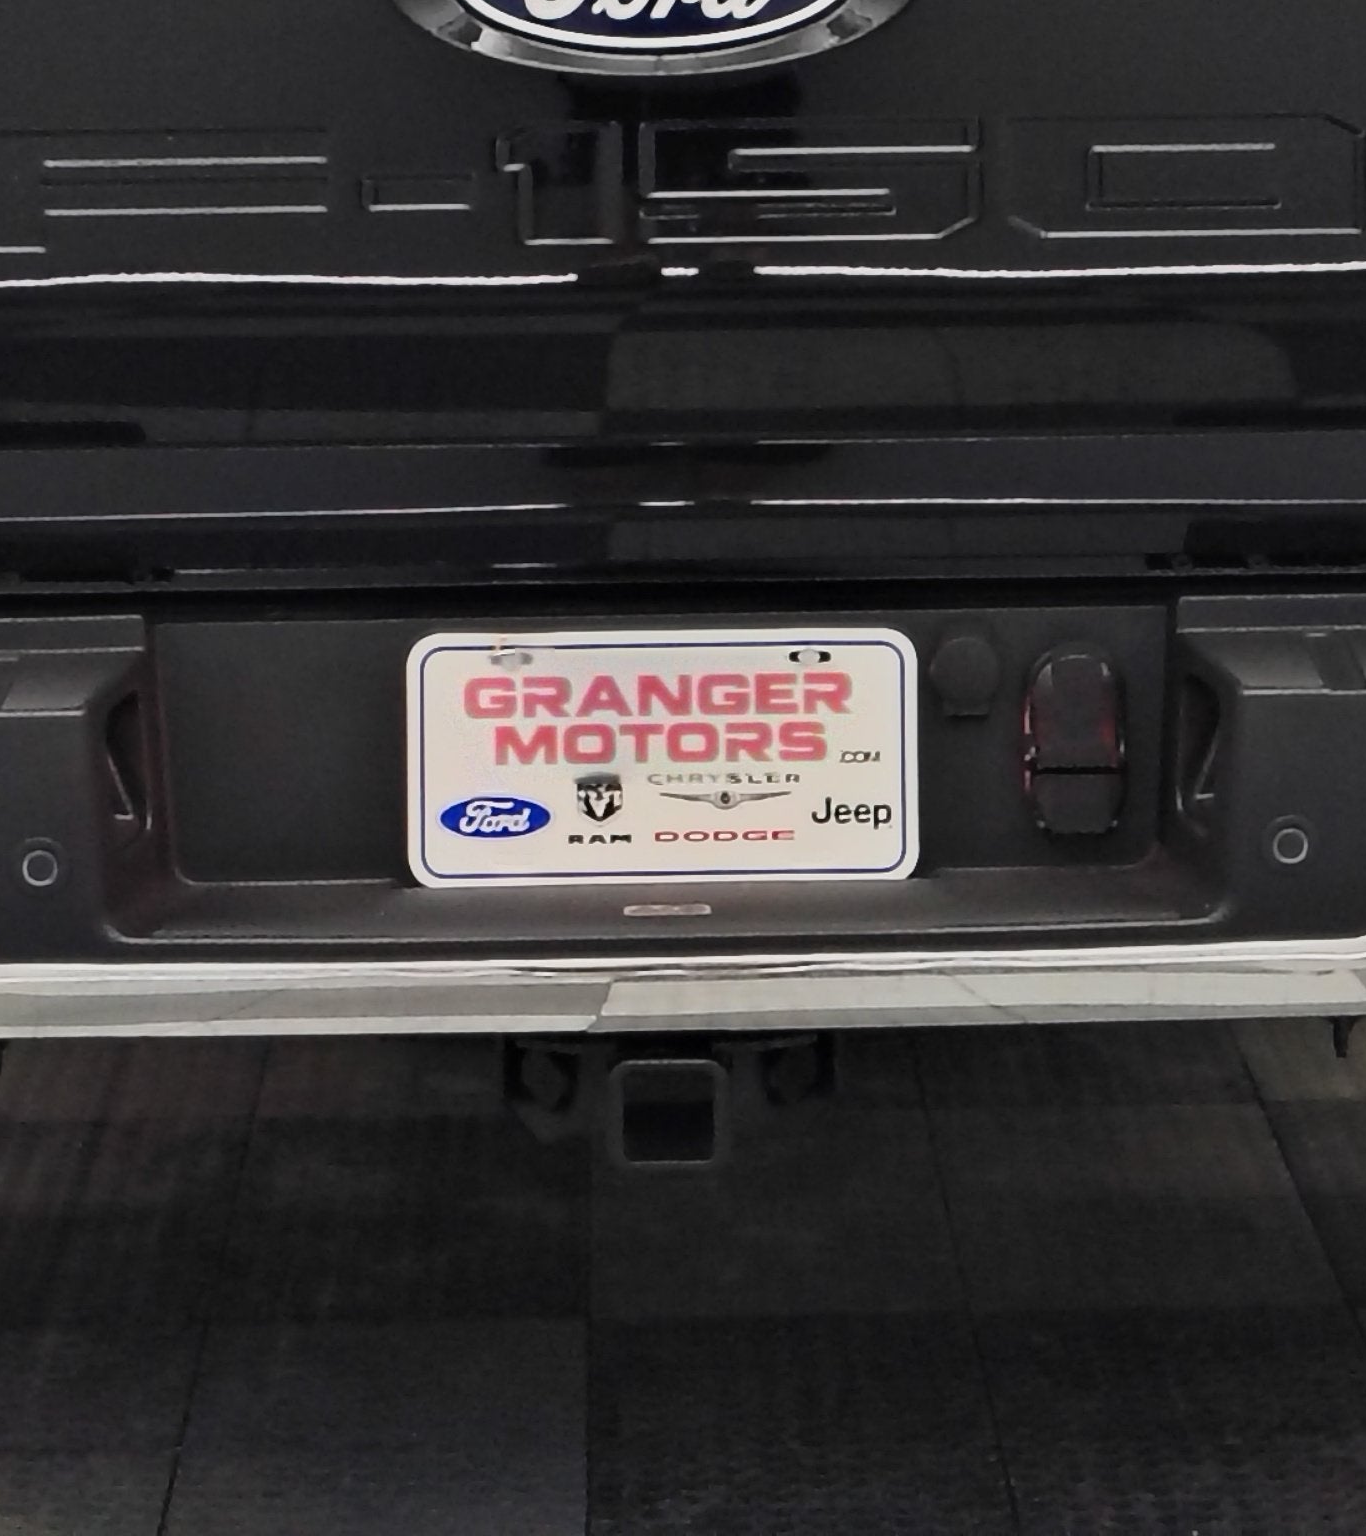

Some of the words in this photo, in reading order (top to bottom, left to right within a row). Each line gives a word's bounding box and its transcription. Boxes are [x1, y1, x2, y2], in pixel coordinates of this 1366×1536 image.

[463, 672, 852, 719] GRANGER
[494, 721, 828, 765] MOTORS
[647, 772, 800, 785] CHRYSLER
[459, 800, 531, 834] Ford
[811, 797, 892, 830] Jeep
[567, 834, 632, 845] RAM
[654, 830, 795, 842] DODGE
